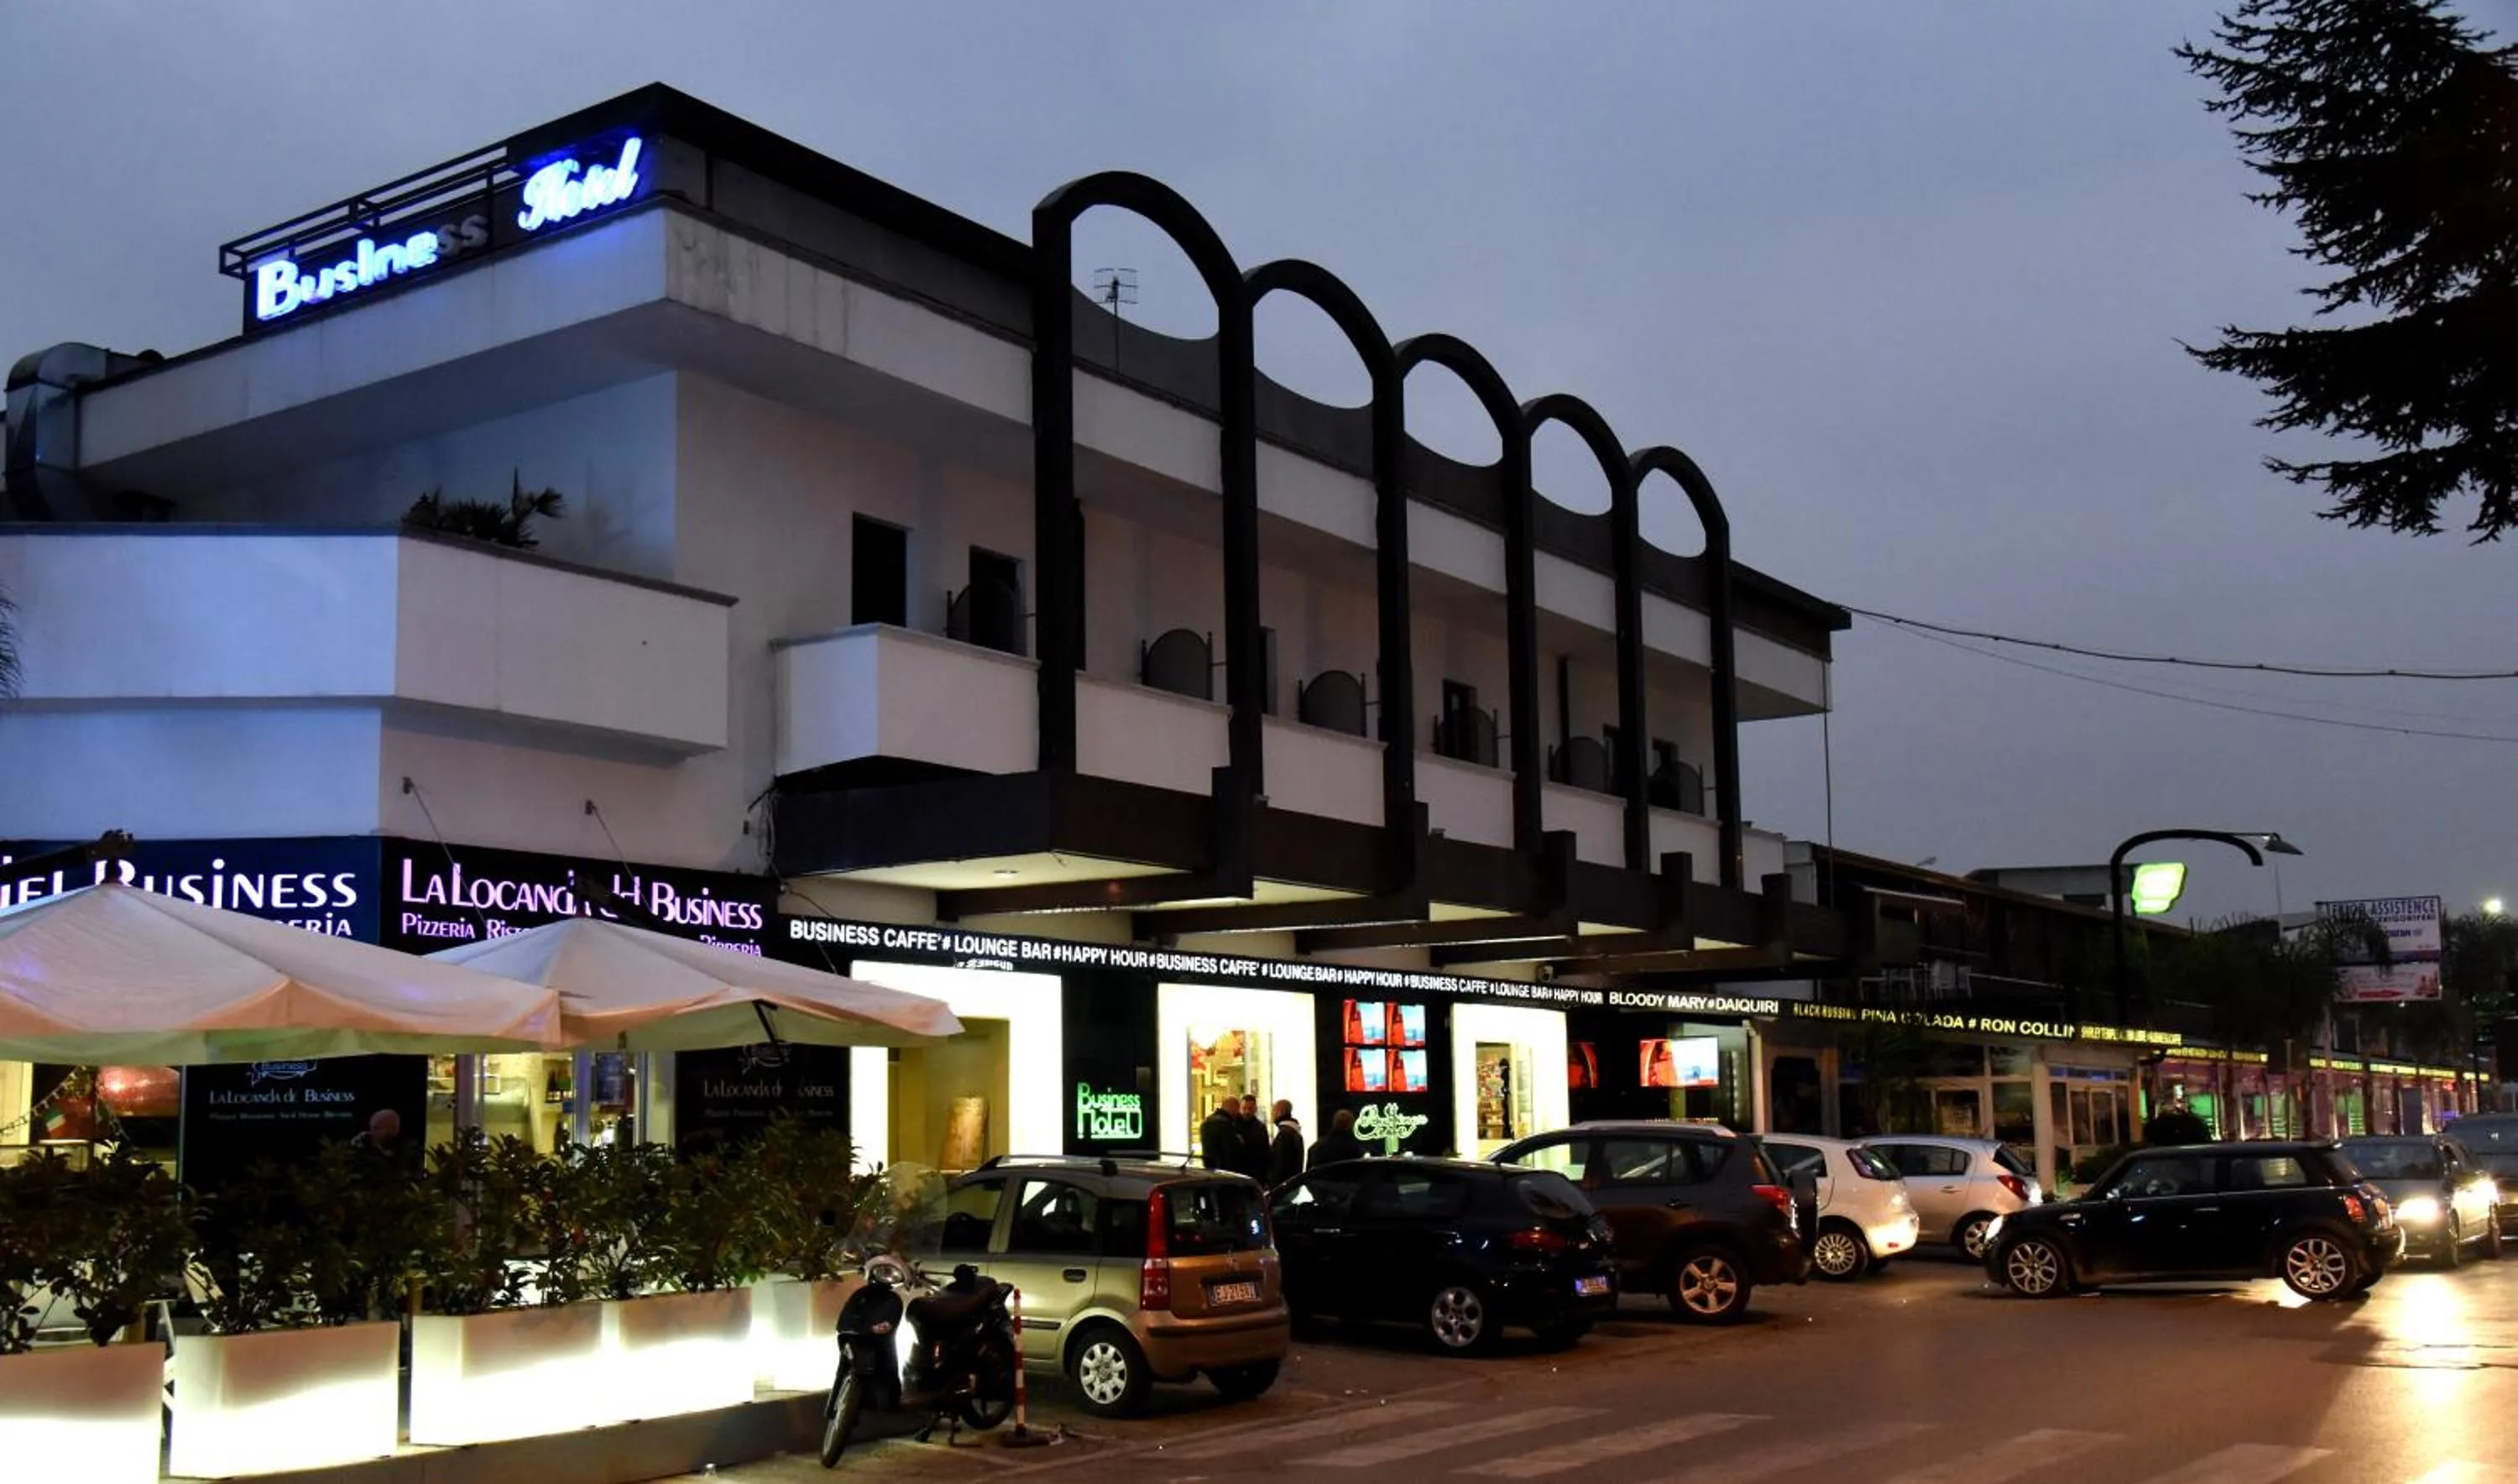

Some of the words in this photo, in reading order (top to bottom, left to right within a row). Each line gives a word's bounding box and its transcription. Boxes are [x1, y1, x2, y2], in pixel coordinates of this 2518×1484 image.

[790, 919, 880, 946] BUSINESS
[954, 934, 1018, 958] LOUNGE
[1021, 941, 1052, 960] BAR
[1062, 944, 1107, 964] HAPPY
[1110, 948, 1147, 968] HOUR
[1157, 953, 1218, 974] BUSINESS
[1270, 963, 1314, 980] LOUNGE
[1315, 966, 1337, 983] BAR
[1344, 969, 1376, 985] HAPPY
[1376, 972, 1403, 987] HOUR
[1410, 975, 1458, 992] BUSINESS
[1495, 982, 1529, 997] LOUNGE
[1609, 992, 1664, 1006] BLOODY
[1668, 995, 1707, 1010] MARY
[1716, 999, 1779, 1014] DAIQUIRI
[1981, 1018, 2015, 1033] RON
